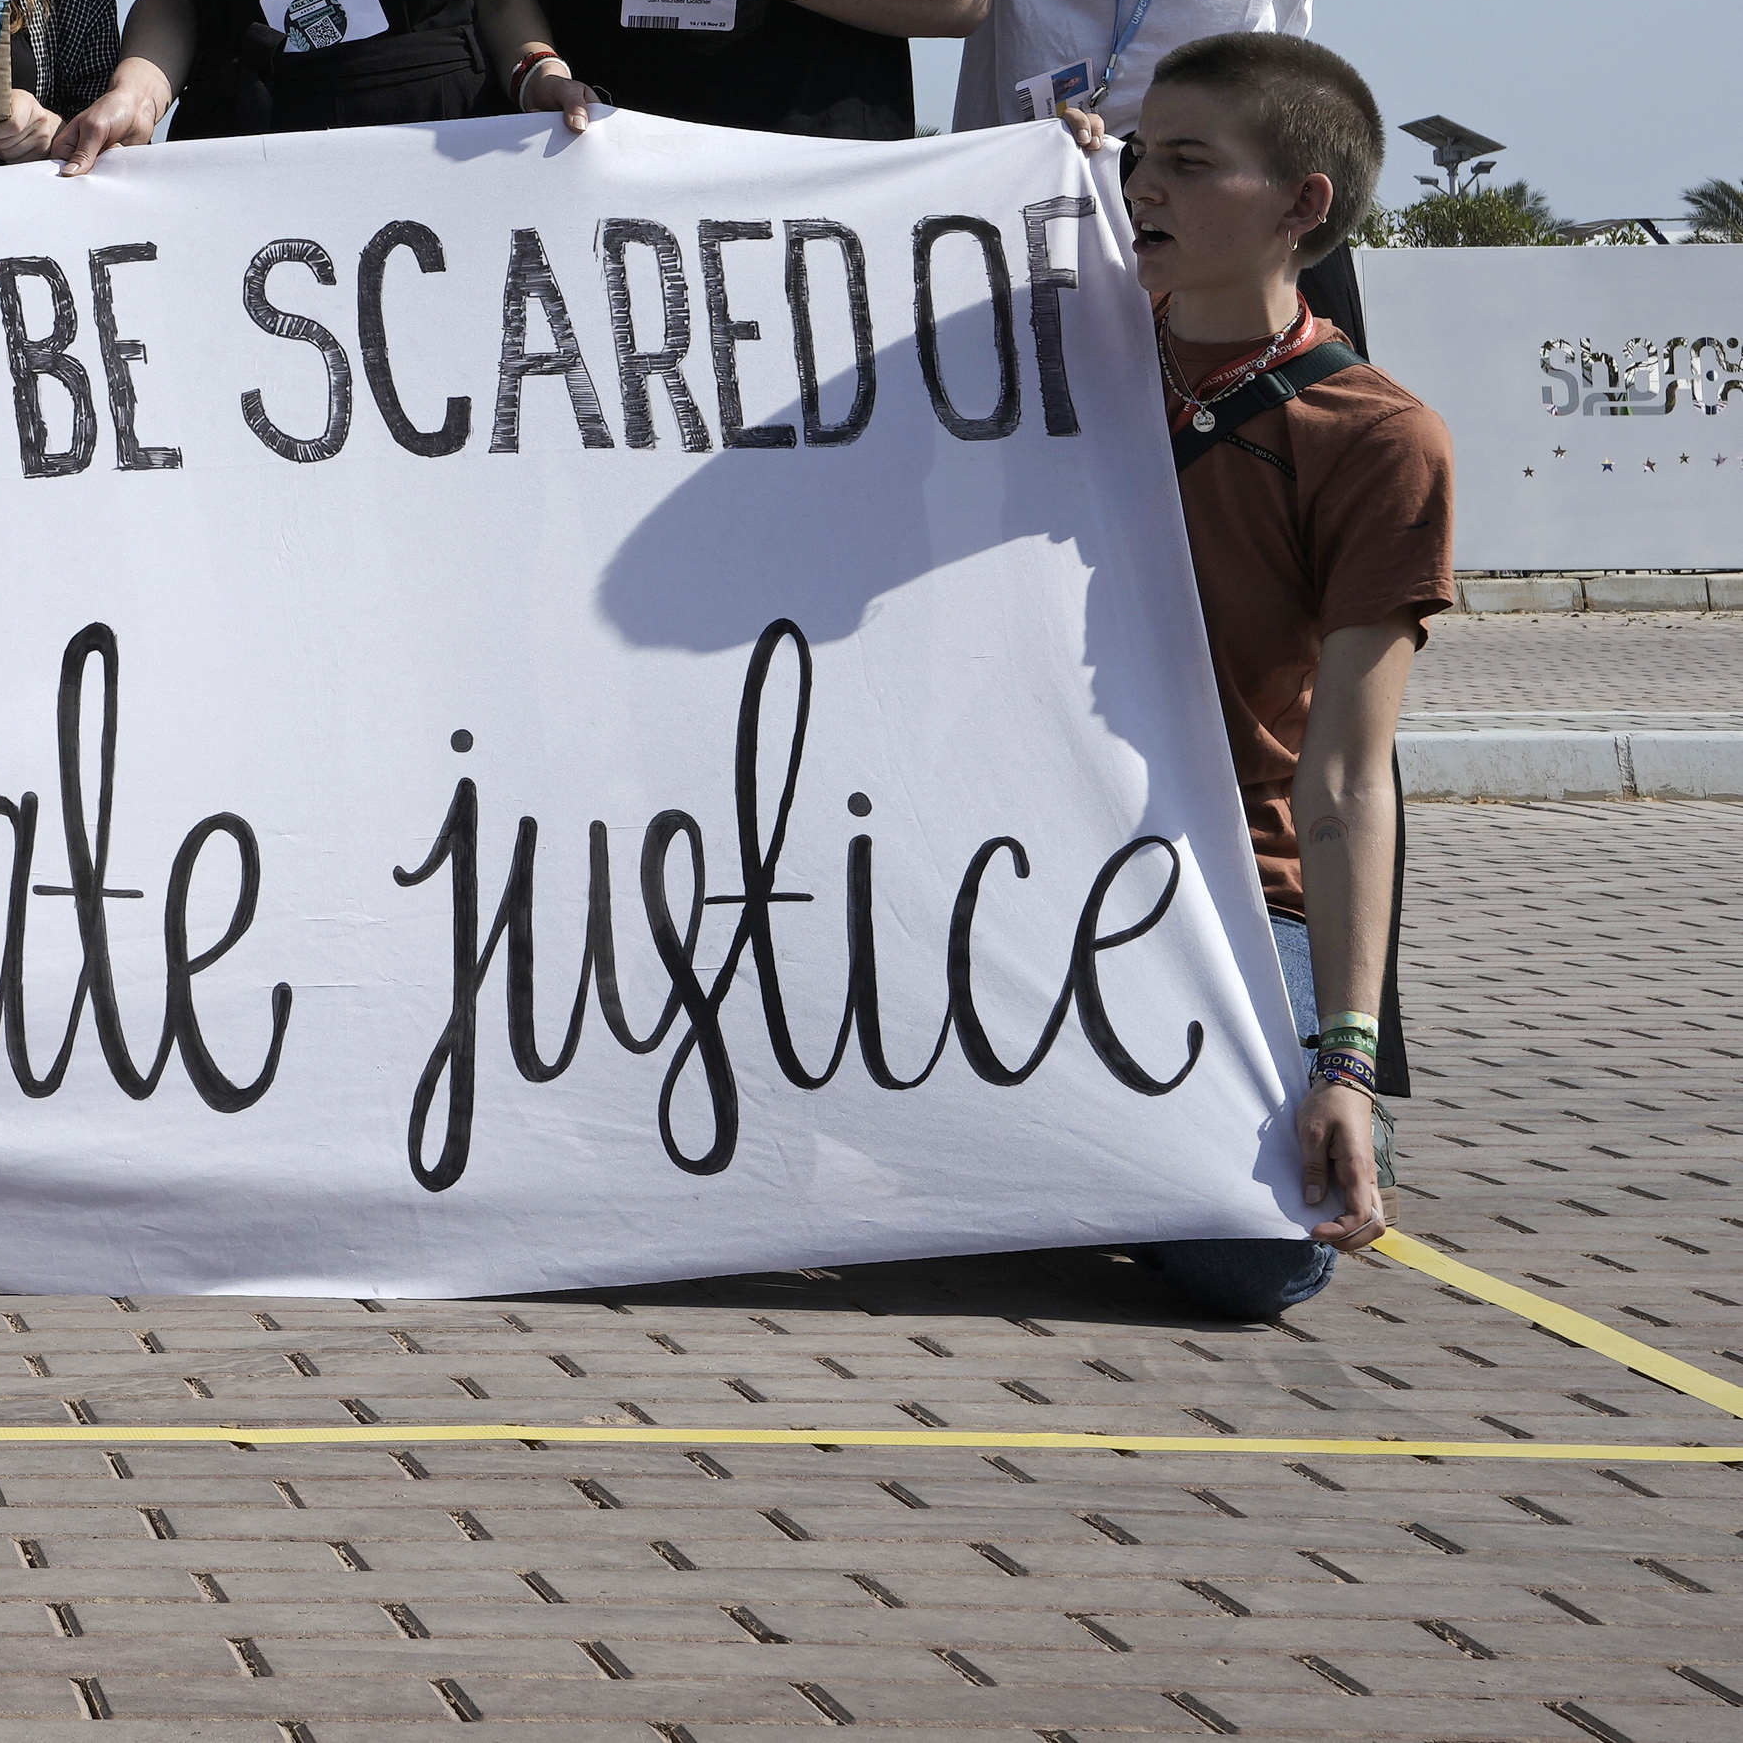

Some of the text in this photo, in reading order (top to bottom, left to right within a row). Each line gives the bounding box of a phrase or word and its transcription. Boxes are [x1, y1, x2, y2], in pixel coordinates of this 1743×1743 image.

[239, 218, 877, 465] SCARED
[910, 193, 1098, 443] OF
[393, 616, 1204, 1194] justice
[1337, 1035, 1361, 1044] ALLE
